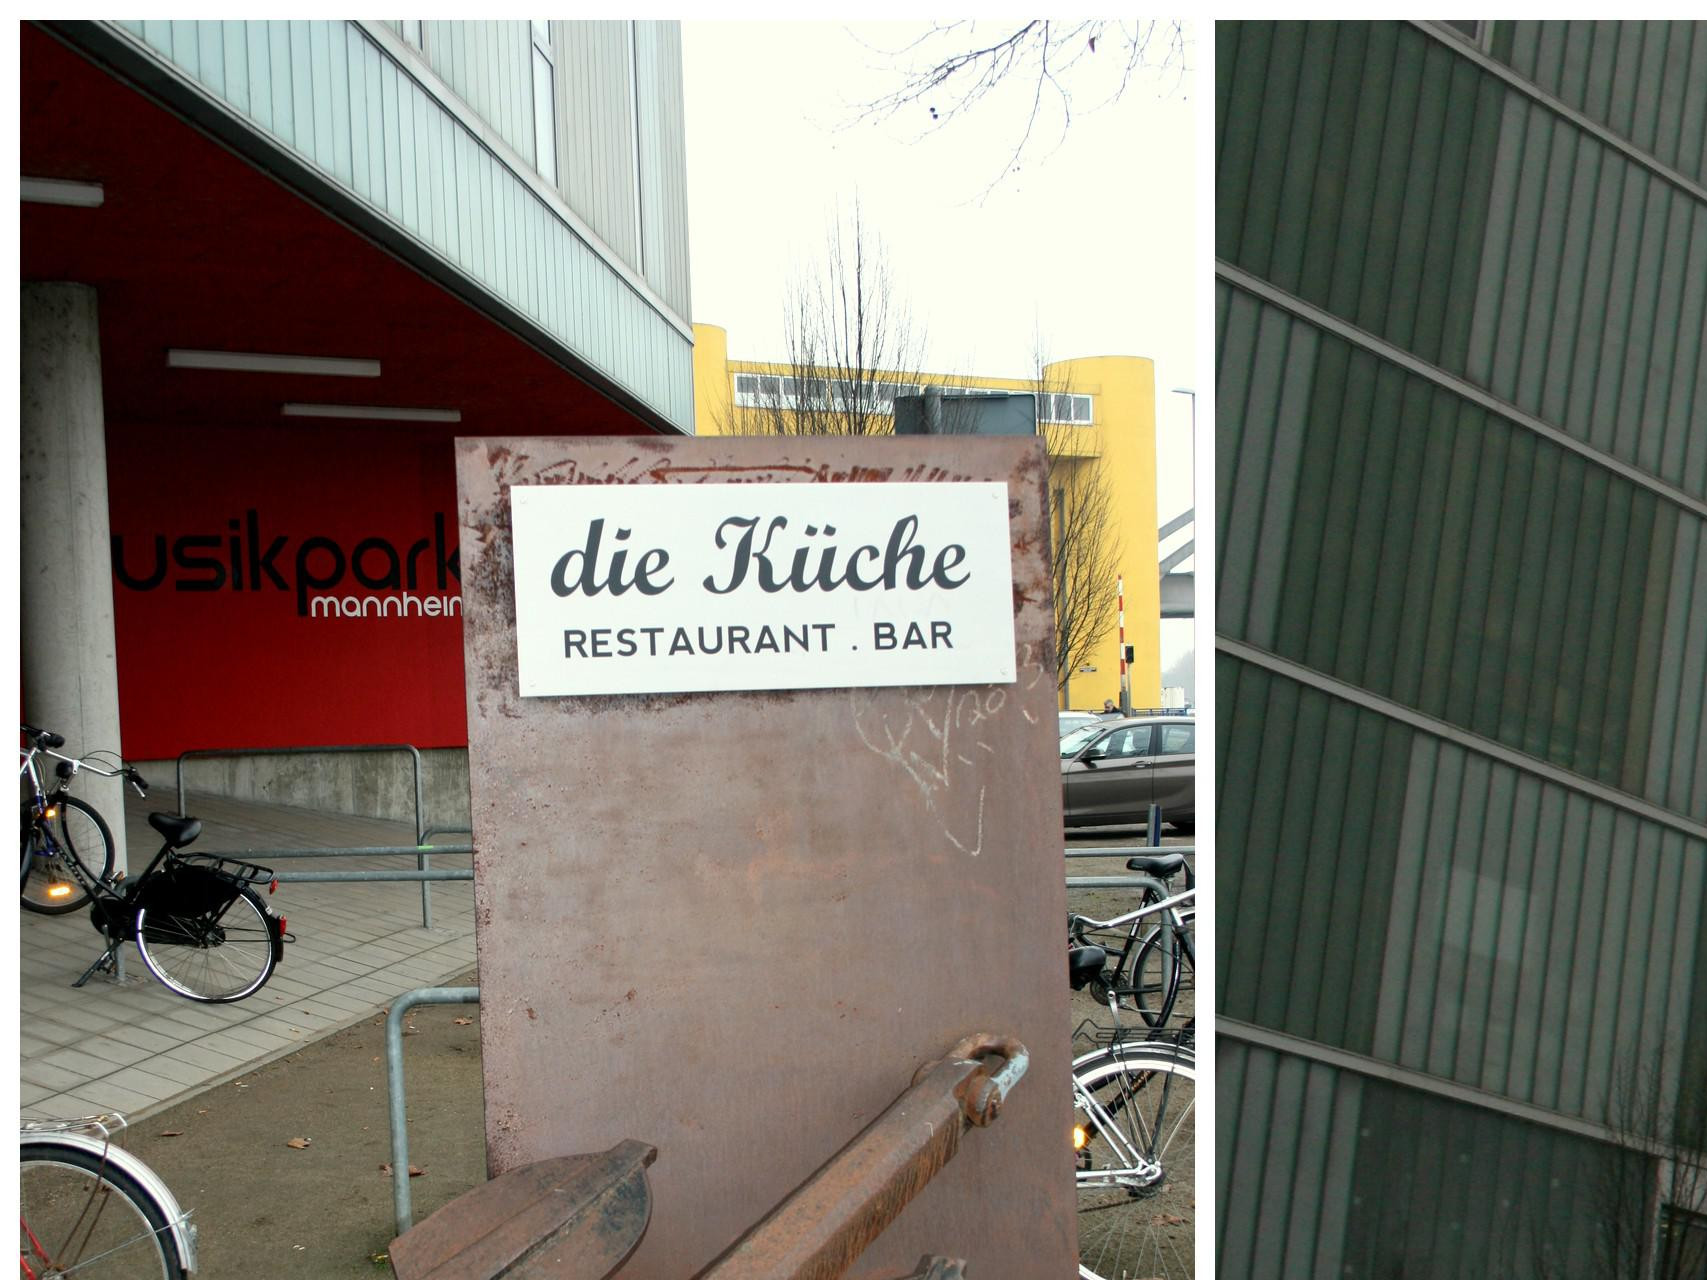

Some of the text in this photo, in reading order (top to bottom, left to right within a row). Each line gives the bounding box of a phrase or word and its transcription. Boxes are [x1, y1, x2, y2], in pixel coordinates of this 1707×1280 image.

[111, 508, 460, 617] usikpark
[550, 514, 971, 598] die Küche
[563, 623, 836, 659] RESTAURANT
[873, 621, 954, 650] BAR
